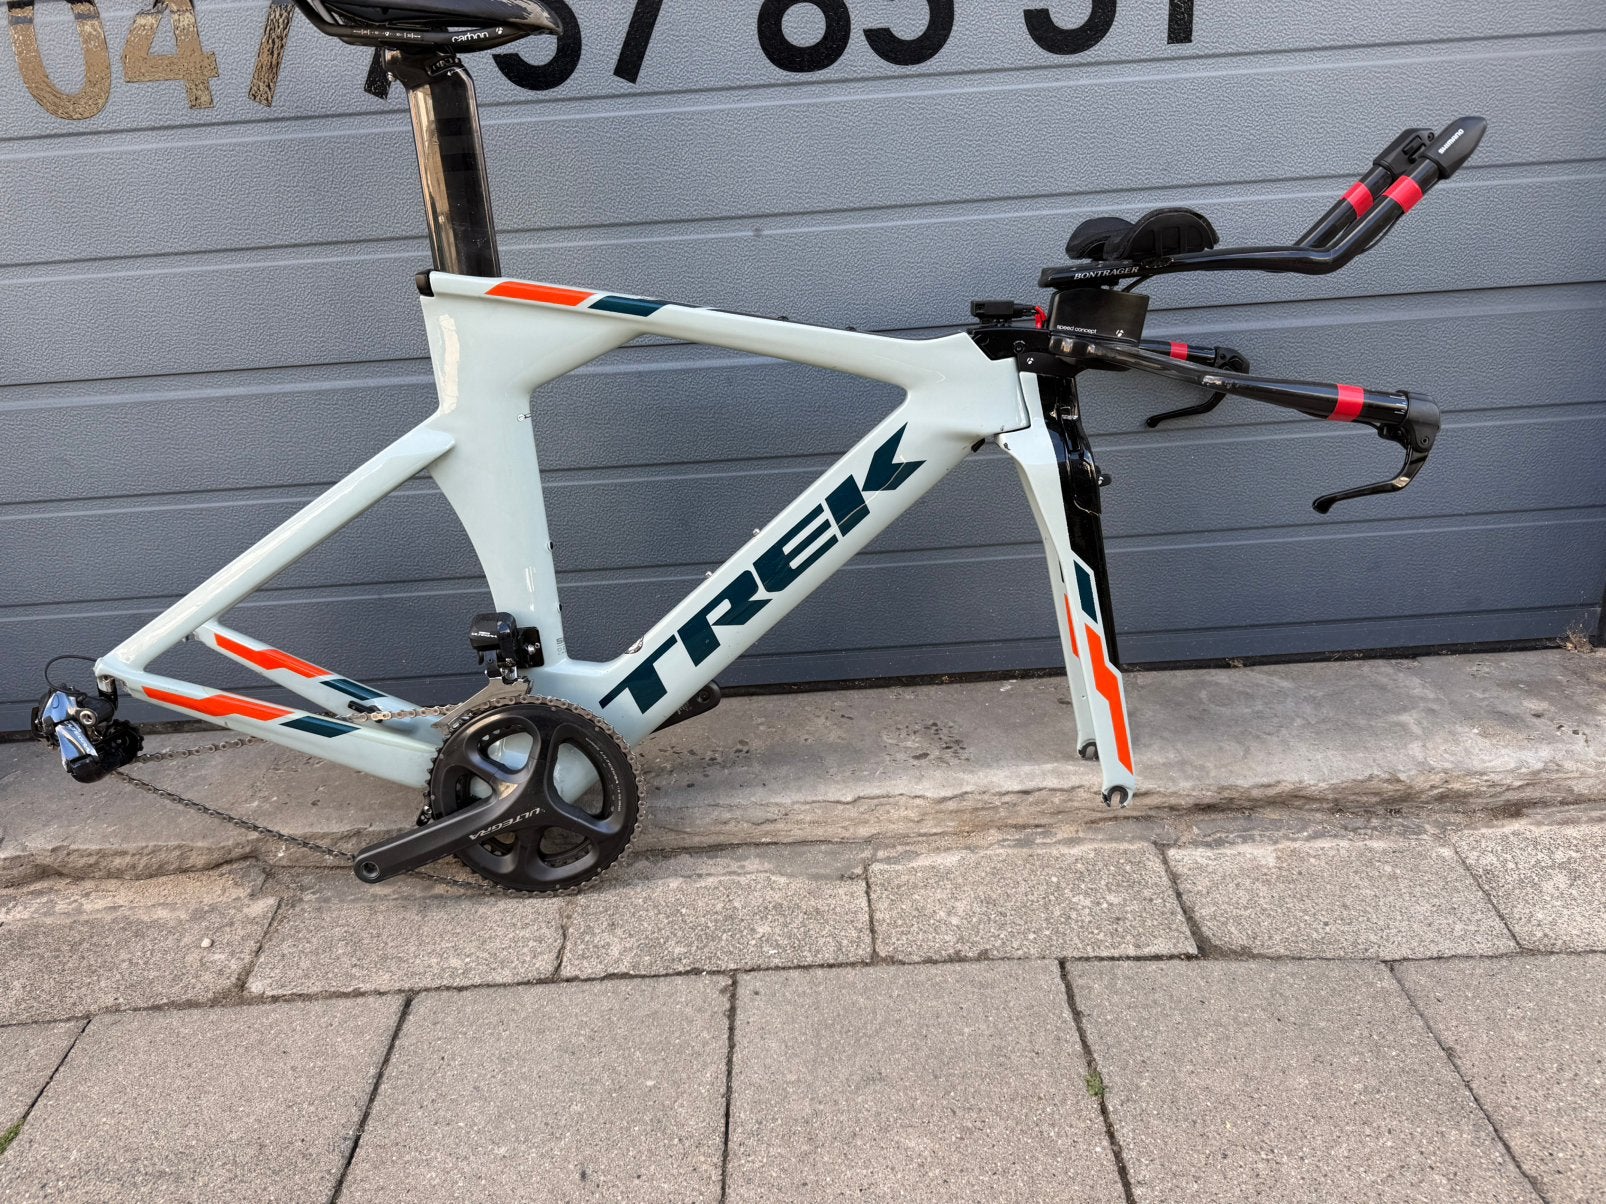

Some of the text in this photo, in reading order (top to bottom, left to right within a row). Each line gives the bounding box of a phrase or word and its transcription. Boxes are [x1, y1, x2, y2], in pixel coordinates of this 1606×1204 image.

[451, 30, 489, 43] carbon
[1073, 266, 1140, 280] BONTRAGER
[598, 421, 928, 715] TREK
[468, 807, 541, 840] ULTEGRA
